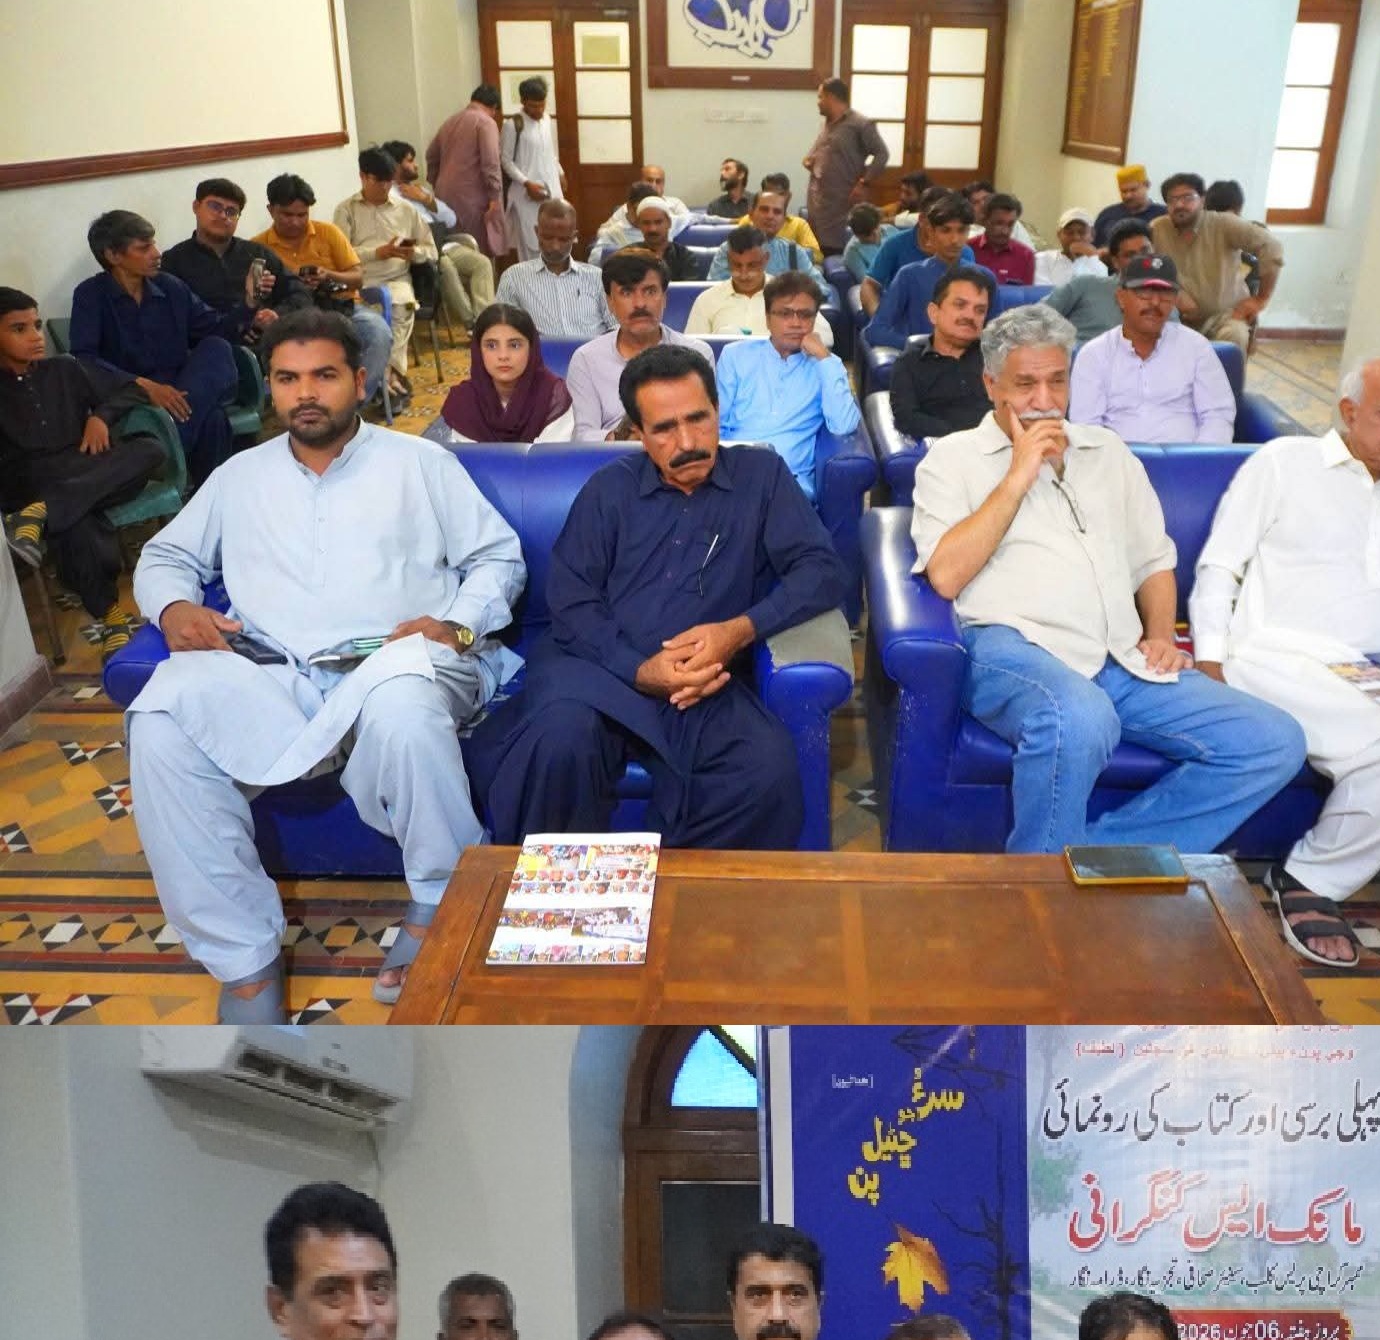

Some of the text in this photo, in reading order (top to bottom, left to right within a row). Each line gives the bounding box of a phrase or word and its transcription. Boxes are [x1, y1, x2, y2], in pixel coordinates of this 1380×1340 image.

[1043, 1077, 1129, 1140] رونمائی
[1133, 1082, 1172, 1142] کی
[1162, 1089, 1253, 1147] کتاب
[1236, 1103, 1278, 1135] اور
[1281, 1102, 1332, 1143] برسی
[847, 1166, 880, 1207] پن
[1069, 1170, 1207, 1251] کنگرانی
[1183, 1182, 1266, 1252] ایس
